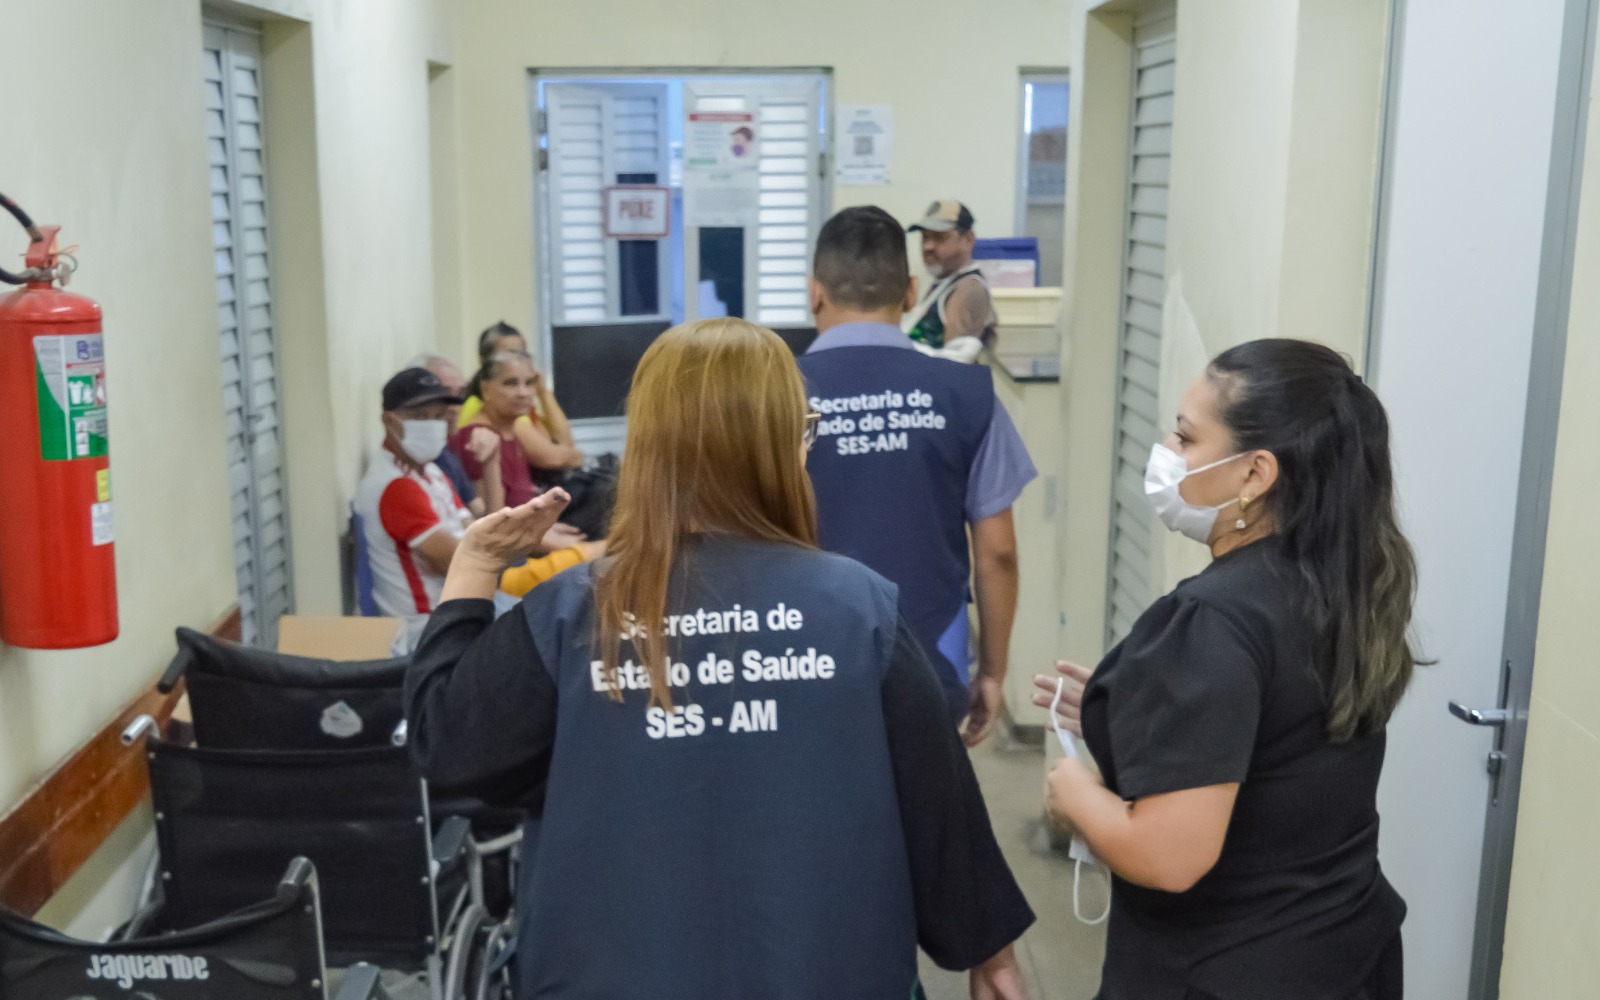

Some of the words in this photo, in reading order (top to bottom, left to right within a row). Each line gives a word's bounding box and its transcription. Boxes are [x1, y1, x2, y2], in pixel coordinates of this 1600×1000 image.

[808, 389, 904, 414] Secretaria
[906, 388, 933, 408] de
[817, 415, 856, 436] ado
[858, 412, 886, 432] de
[887, 409, 947, 430] Saúde
[836, 431, 909, 456] SES-AM
[766, 602, 804, 631] de
[697, 652, 735, 685] de
[741, 647, 836, 682] Saúde
[645, 703, 706, 739] SES
[711, 715, 724, 727] -
[728, 699, 778, 733] AM
[86, 953, 210, 989] Jaguaribe
